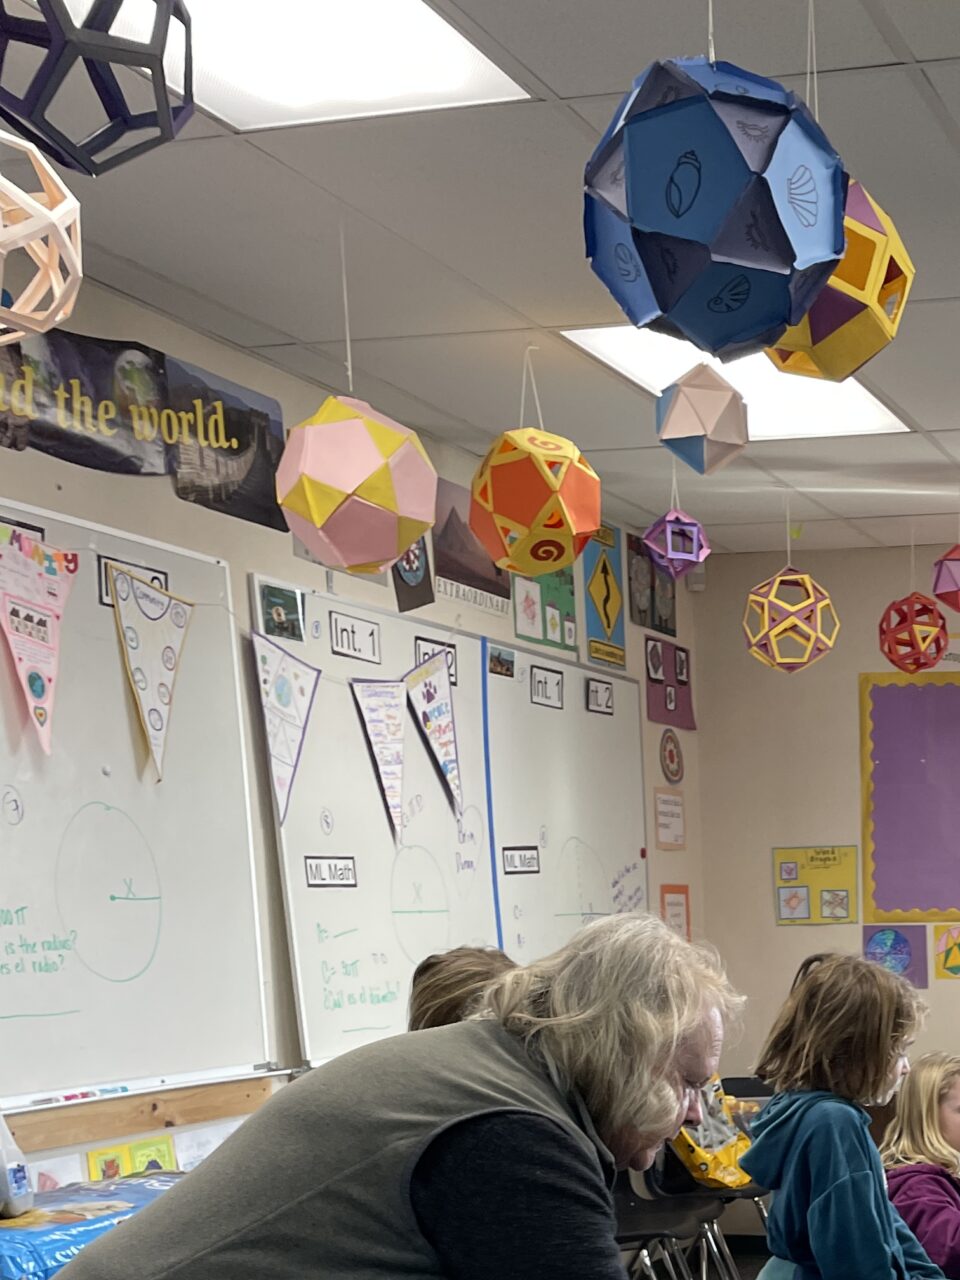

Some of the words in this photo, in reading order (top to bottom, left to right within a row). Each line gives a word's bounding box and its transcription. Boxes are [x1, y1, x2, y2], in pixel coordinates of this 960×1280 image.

[54, 379, 118, 436] the
[129, 398, 239, 449] world.
[335, 617, 362, 653] Int.
[368, 628, 376, 657] 1
[309, 863, 326, 881] ML
[328, 861, 354, 881] Math
[505, 855, 518, 869] ML
[519, 854, 537, 869] Math
